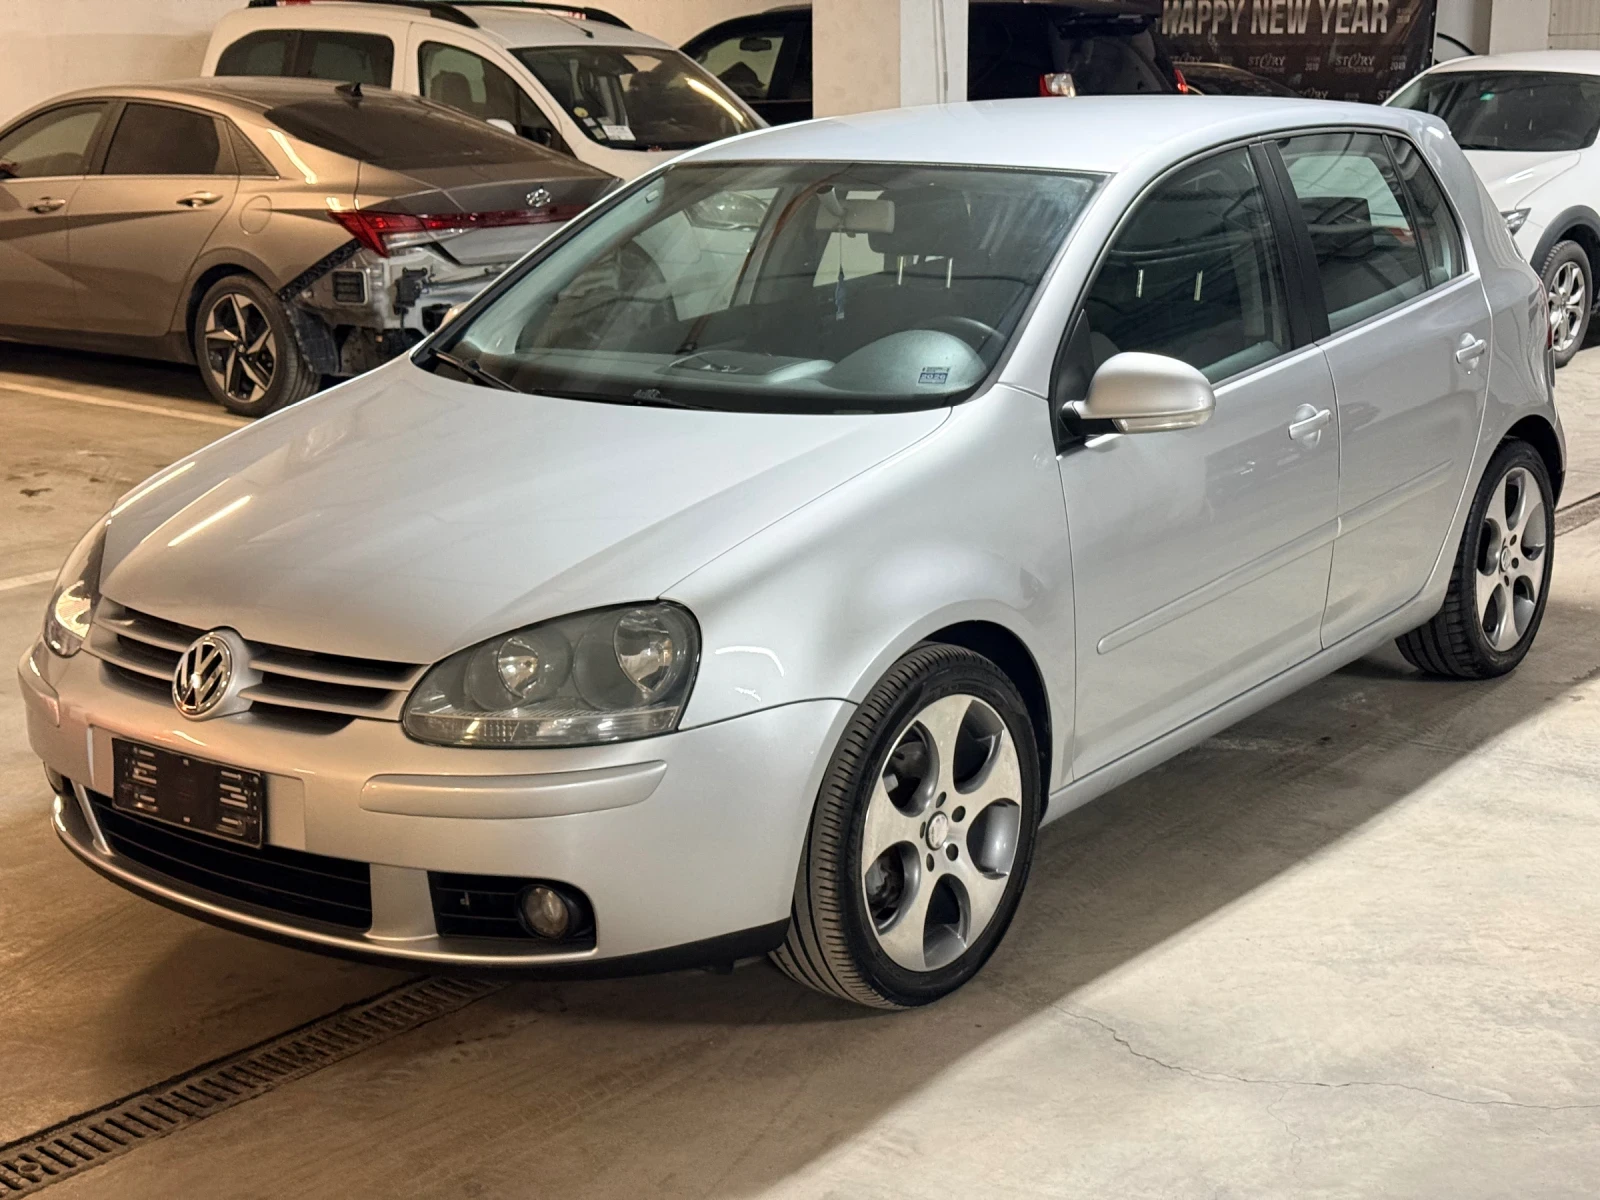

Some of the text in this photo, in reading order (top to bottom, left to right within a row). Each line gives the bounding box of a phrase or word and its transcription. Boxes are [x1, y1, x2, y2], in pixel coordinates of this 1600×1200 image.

[1161, 0, 1245, 35] HAPPY
[1250, 0, 1311, 34] NEW
[1319, 0, 1389, 34] YEAR
[1248, 53, 1285, 69] STORY
[1335, 52, 1376, 69] STORY
[173, 634, 233, 718] VW
